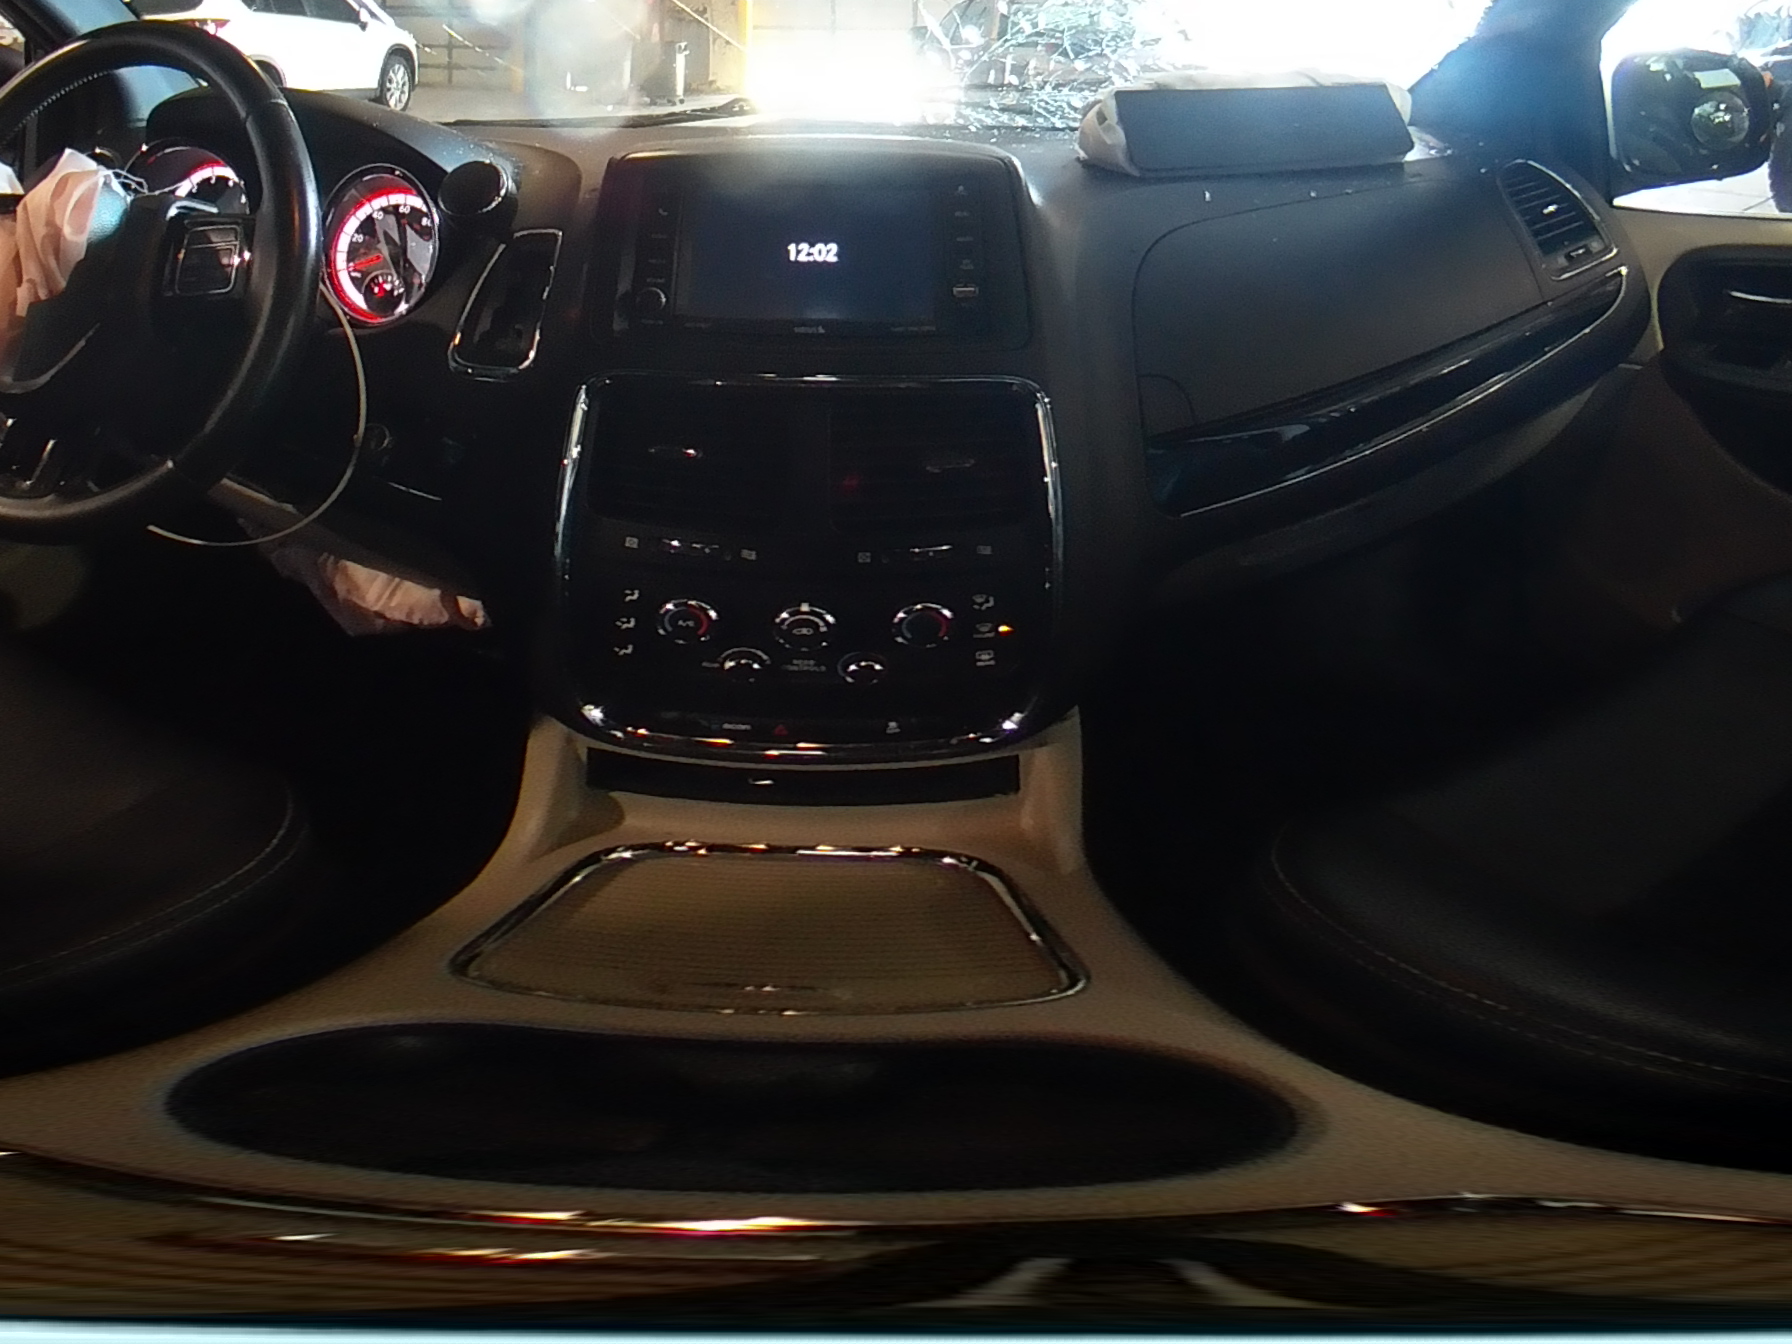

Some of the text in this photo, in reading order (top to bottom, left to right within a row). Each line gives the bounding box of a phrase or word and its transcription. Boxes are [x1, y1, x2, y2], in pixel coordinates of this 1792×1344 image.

[398, 205, 410, 214] 60
[372, 211, 384, 220] 40
[352, 233, 364, 243] 20
[787, 242, 839, 263] 12:02
